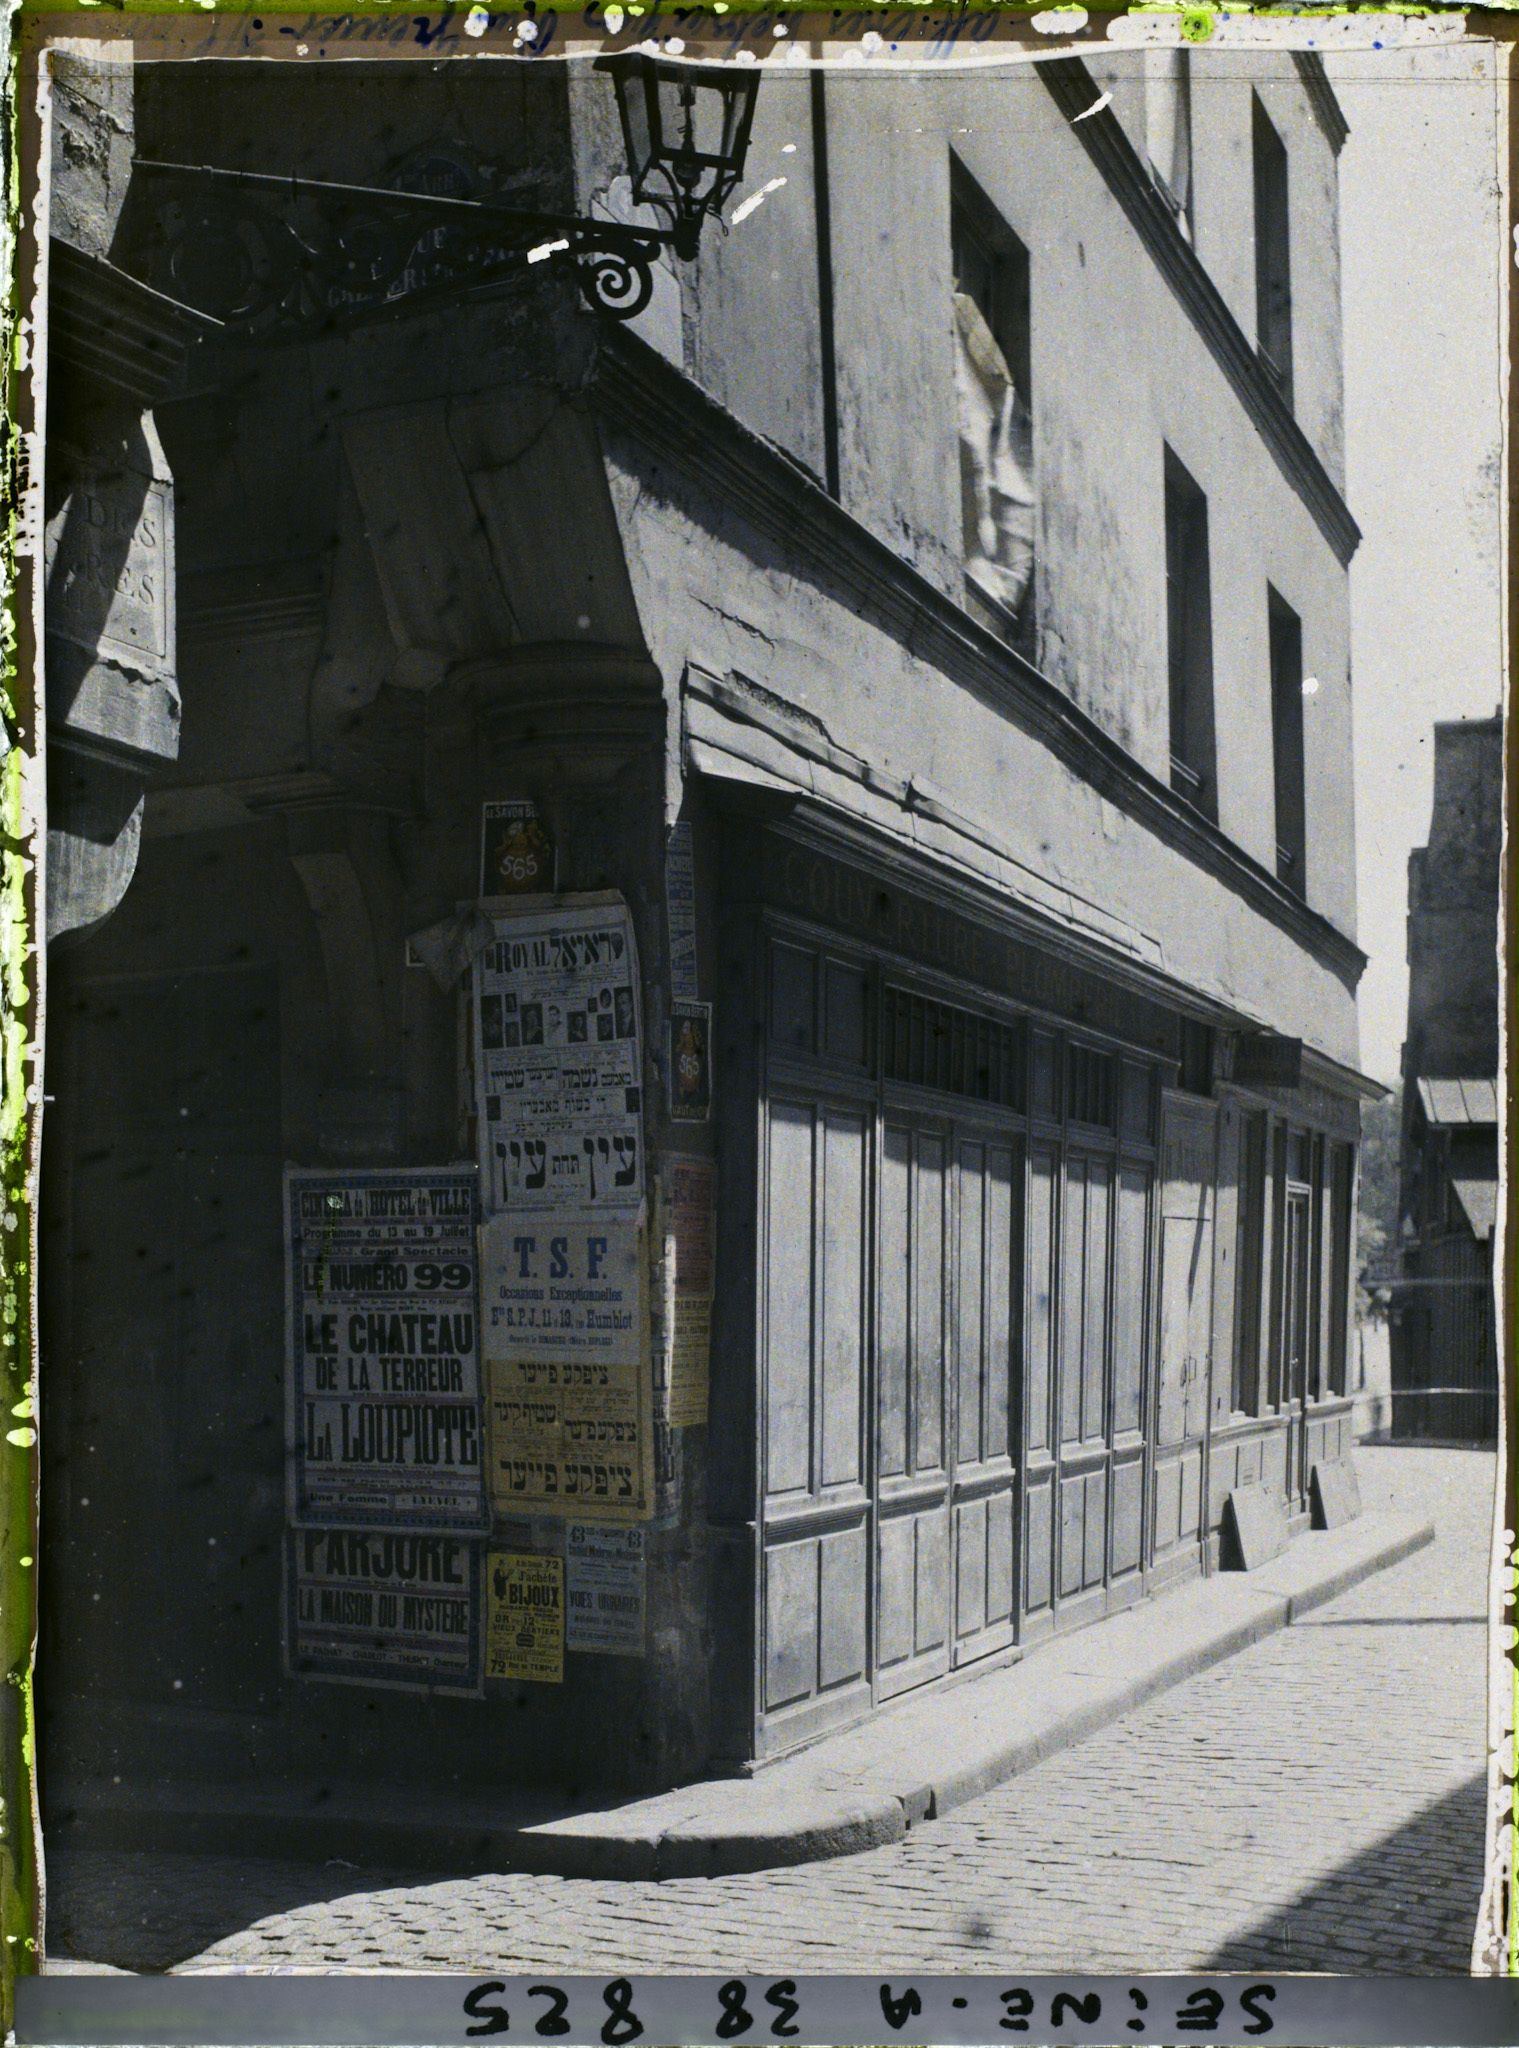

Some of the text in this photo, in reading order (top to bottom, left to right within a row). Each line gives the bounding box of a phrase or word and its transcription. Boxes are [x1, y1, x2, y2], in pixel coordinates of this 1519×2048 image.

[495, 805, 524, 818] SAVON
[500, 853, 538, 881] 565
[496, 1139, 546, 1204] עין
[583, 1136, 636, 1200] עין
[429, 1188, 471, 1216] VILLE
[304, 1222, 470, 1240] Programme du 13 au 19 Juillet
[360, 1246, 399, 1257] Grand
[403, 1246, 469, 1257] Spectacle
[304, 1262, 473, 1291] LE NUMERO 99
[500, 1285, 623, 1304] Occasions Exceptionnelles
[587, 1308, 633, 1330] Humblot
[305, 1313, 473, 1355] LE CHATEAU
[316, 1357, 463, 1392] DE LA TERREUR
[341, 1403, 478, 1466] LOUPIOTE
[500, 1460, 632, 1496] ציפקע פייער
[310, 1492, 334, 1503] Une
[305, 1530, 464, 1584] PARJURE
[545, 1559, 559, 1570] 72
[298, 1587, 315, 1622] LA
[321, 1589, 373, 1627] MAISON
[378, 1593, 397, 1628] DU
[509, 1583, 560, 1608] BIJOUX
[569, 1590, 593, 1609] VOIES
[490, 1659, 506, 1674] 72
